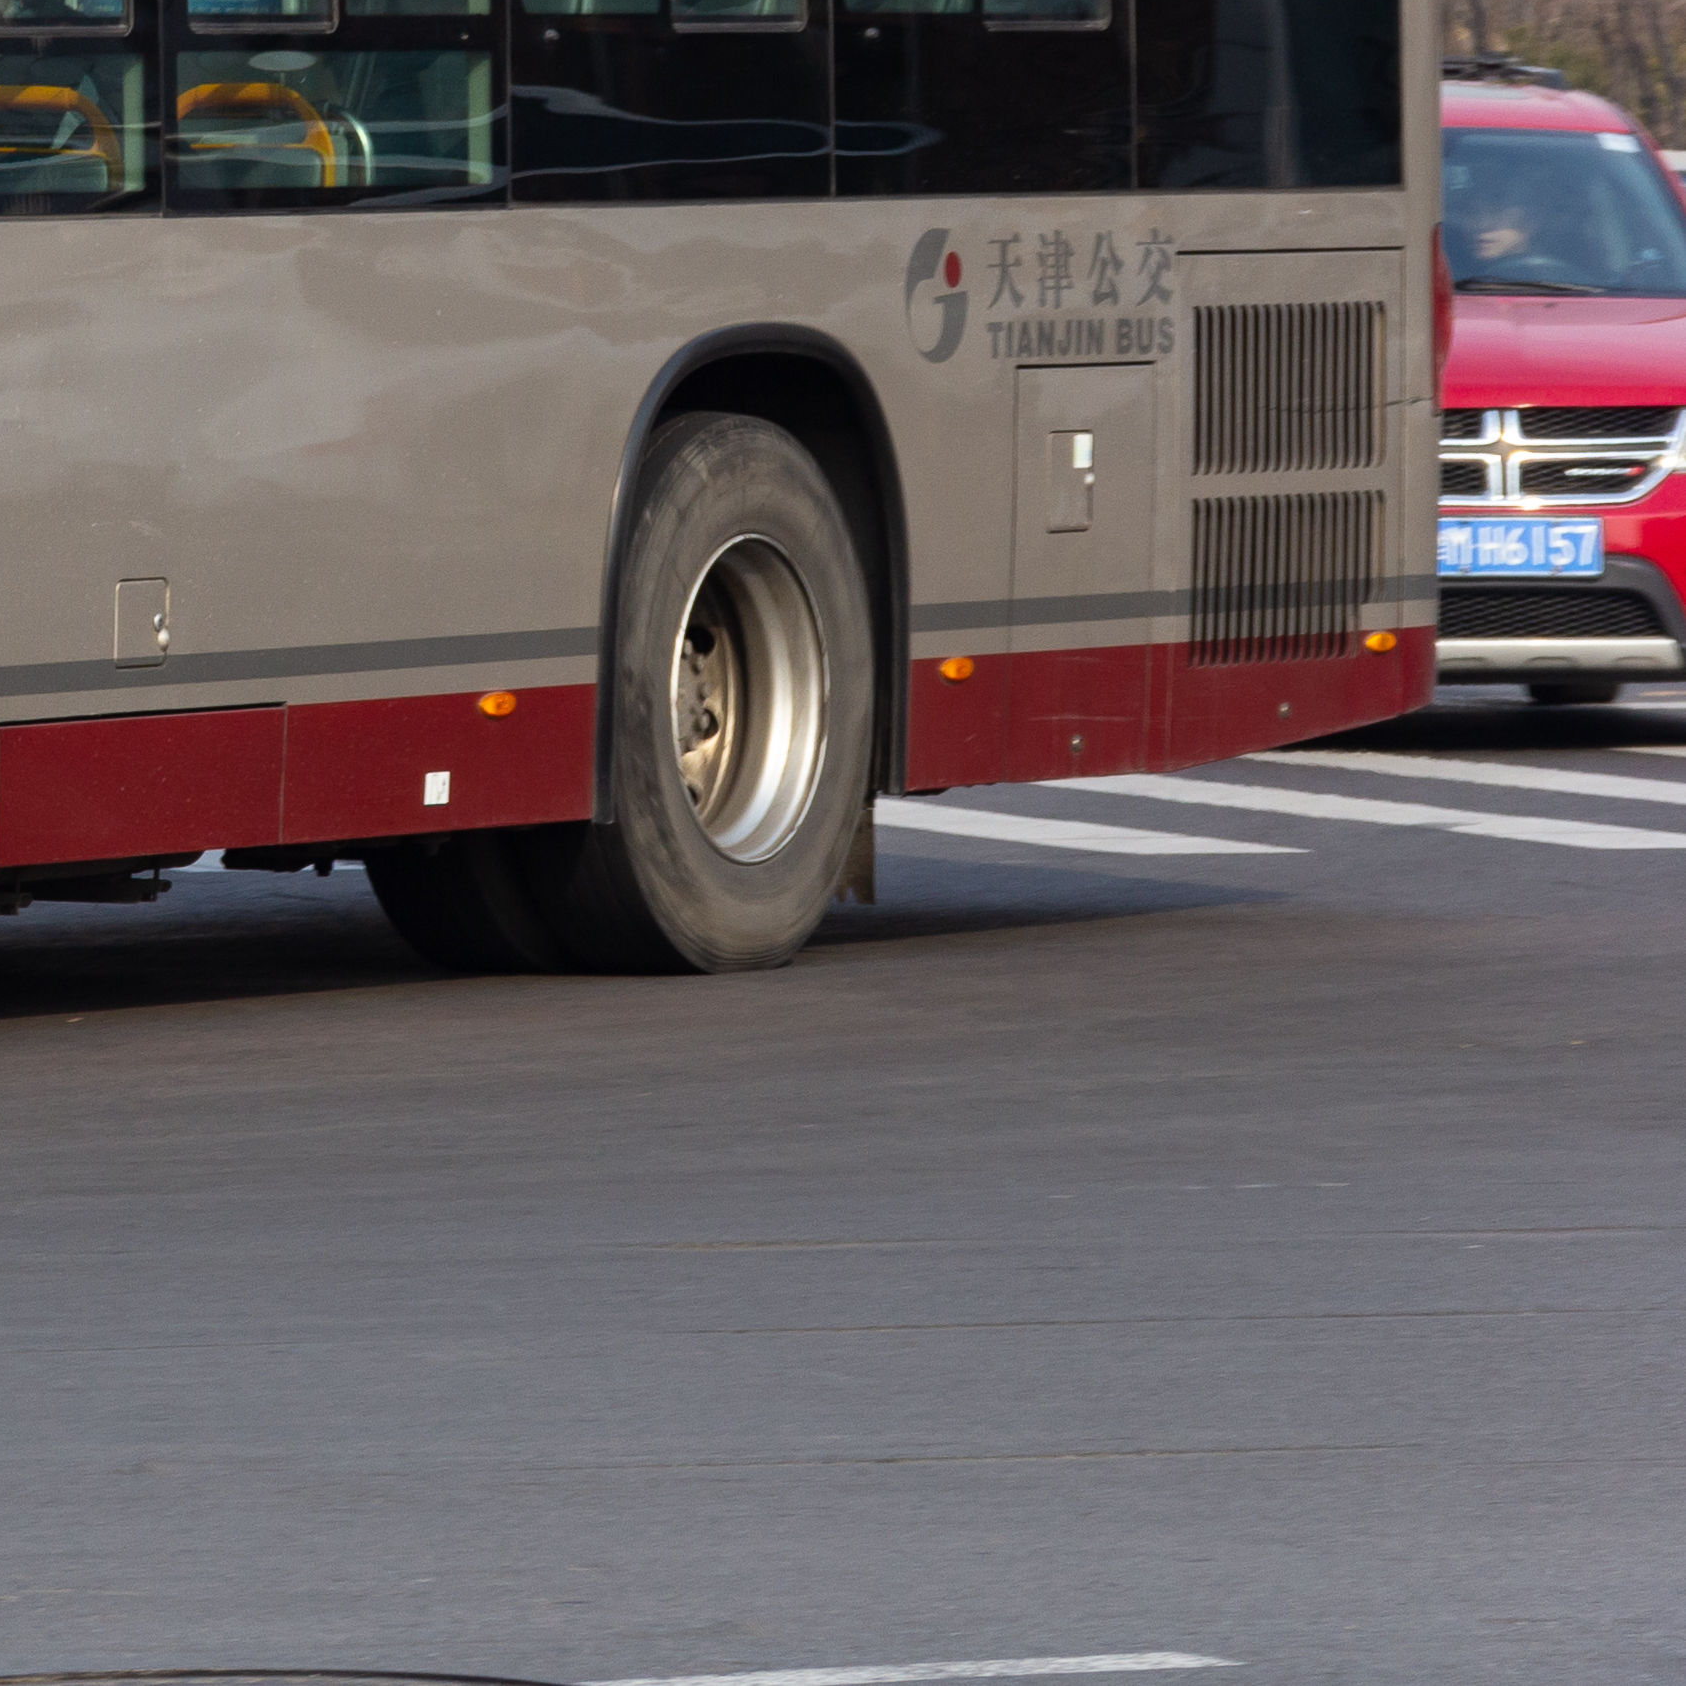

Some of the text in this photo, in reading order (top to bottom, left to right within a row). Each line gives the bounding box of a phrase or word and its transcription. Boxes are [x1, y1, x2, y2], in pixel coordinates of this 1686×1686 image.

[986, 227, 1175, 310] 天津公交
[986, 316, 1175, 359] TIANJIN BUS
